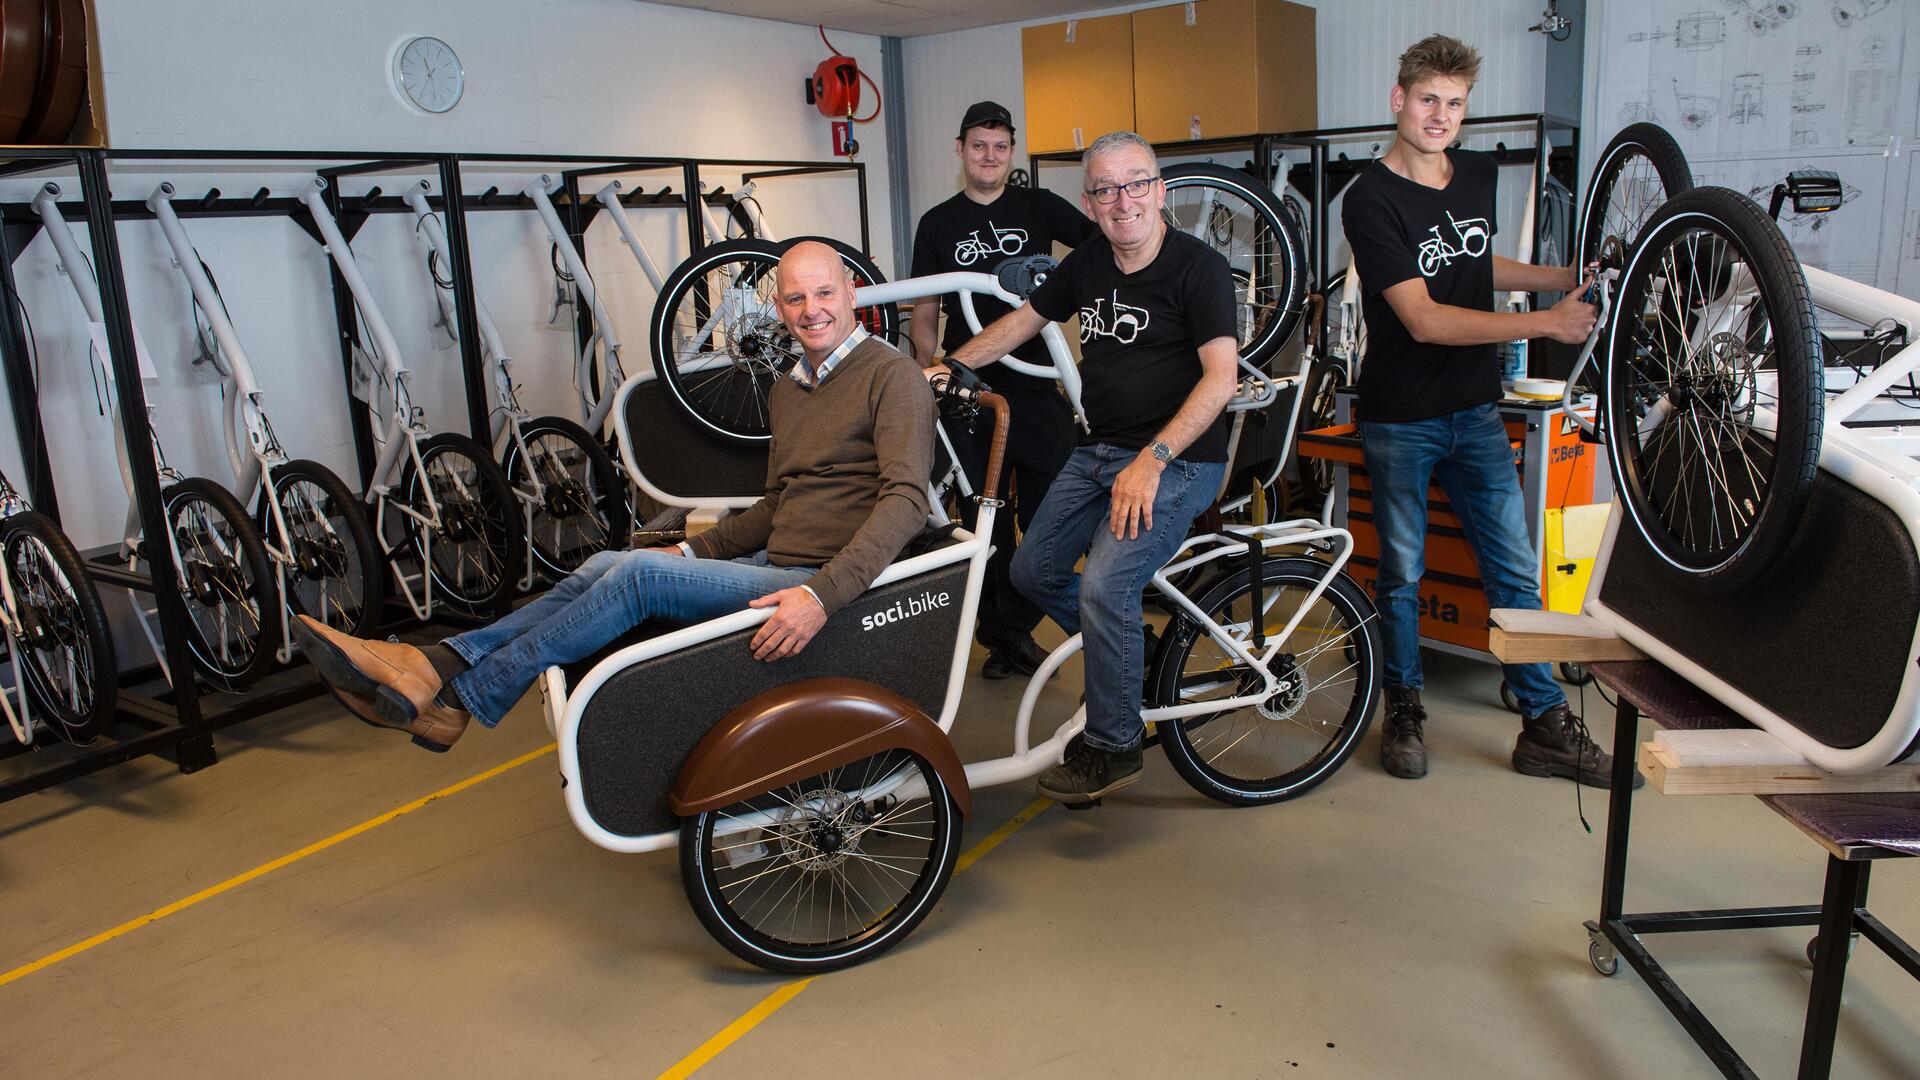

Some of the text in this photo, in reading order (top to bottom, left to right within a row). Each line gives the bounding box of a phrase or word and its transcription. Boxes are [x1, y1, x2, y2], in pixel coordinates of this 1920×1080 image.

[1561, 444, 1584, 462] Beta
[861, 591, 950, 631] soci.bike
[1417, 594, 1459, 624] eta
